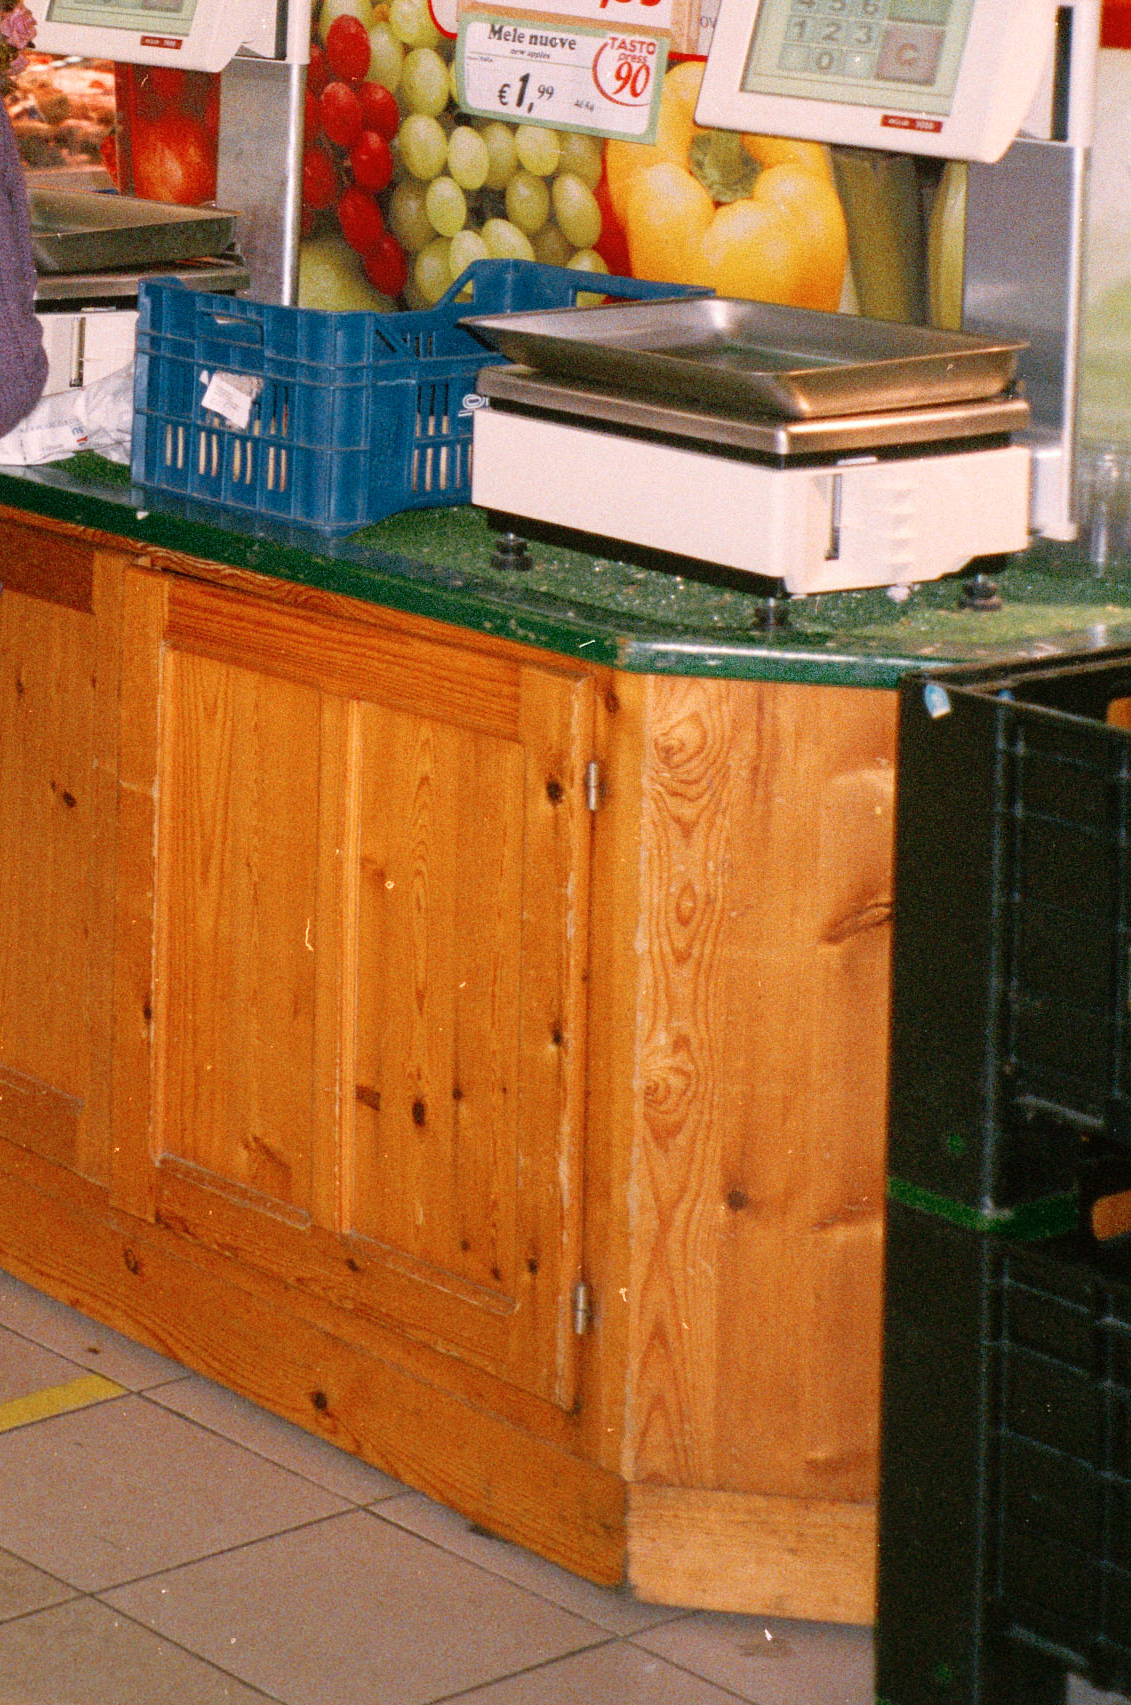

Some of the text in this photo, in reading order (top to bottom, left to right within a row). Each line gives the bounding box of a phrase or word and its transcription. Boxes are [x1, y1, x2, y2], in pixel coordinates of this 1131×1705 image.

[487, 23, 577, 50] Mele nuove
[791, 19, 872, 44] 1 2 3
[609, 36, 656, 56] TASTO
[617, 52, 648, 64] press
[895, 42, 918, 67] C
[815, 52, 834, 71] 0
[612, 60, 651, 98] 90
